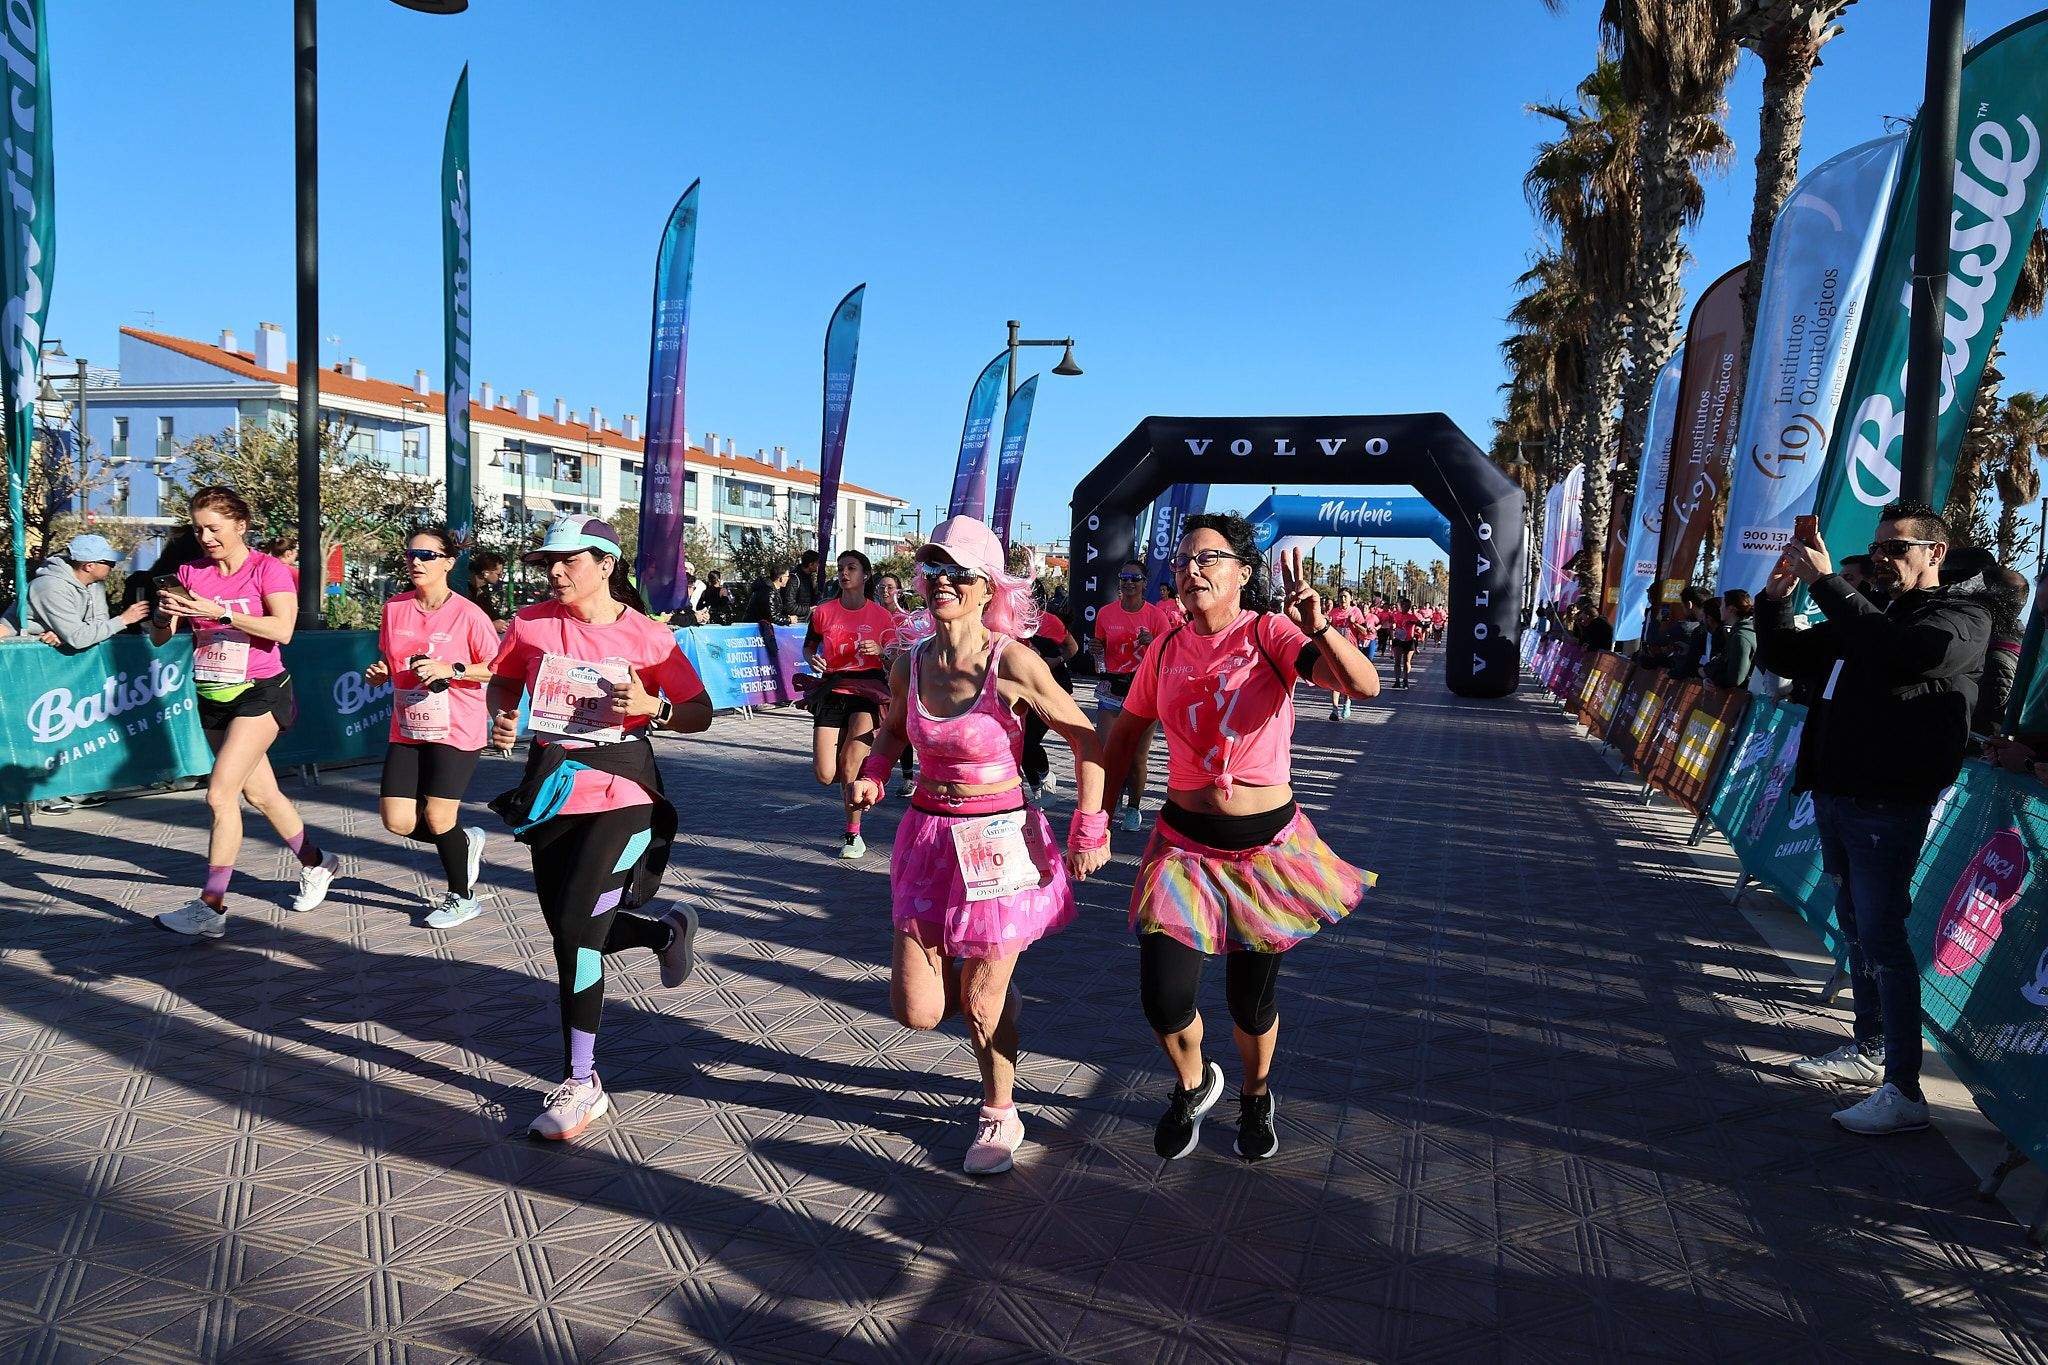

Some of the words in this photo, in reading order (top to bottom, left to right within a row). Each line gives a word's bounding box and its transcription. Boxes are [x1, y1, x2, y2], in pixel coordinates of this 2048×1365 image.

[1774, 313, 1807, 405] Institutos
[1799, 267, 1839, 406] Odontológicos
[1830, 357, 1848, 408] Clínicas
[1840, 300, 1858, 356] dentales
[1184, 437, 1389, 456] VOLVO
[1689, 390, 1711, 465] Institutos
[1153, 506, 1172, 560] GOYA
[1318, 500, 1393, 532] Marlene
[1743, 531, 1768, 542] 900
[1771, 532, 1788, 542] 131
[1472, 522, 1492, 676] VOLVO
[206, 651, 227, 661] 016
[26, 658, 186, 743] Batiste
[409, 712, 430, 721] 016
[565, 693, 599, 710] 016
[44, 728, 120, 770] CHAMPÚ
[126, 718, 149, 736] EN
[155, 698, 193, 724] SECO
[1942, 918, 1978, 954] ESPAÑA
